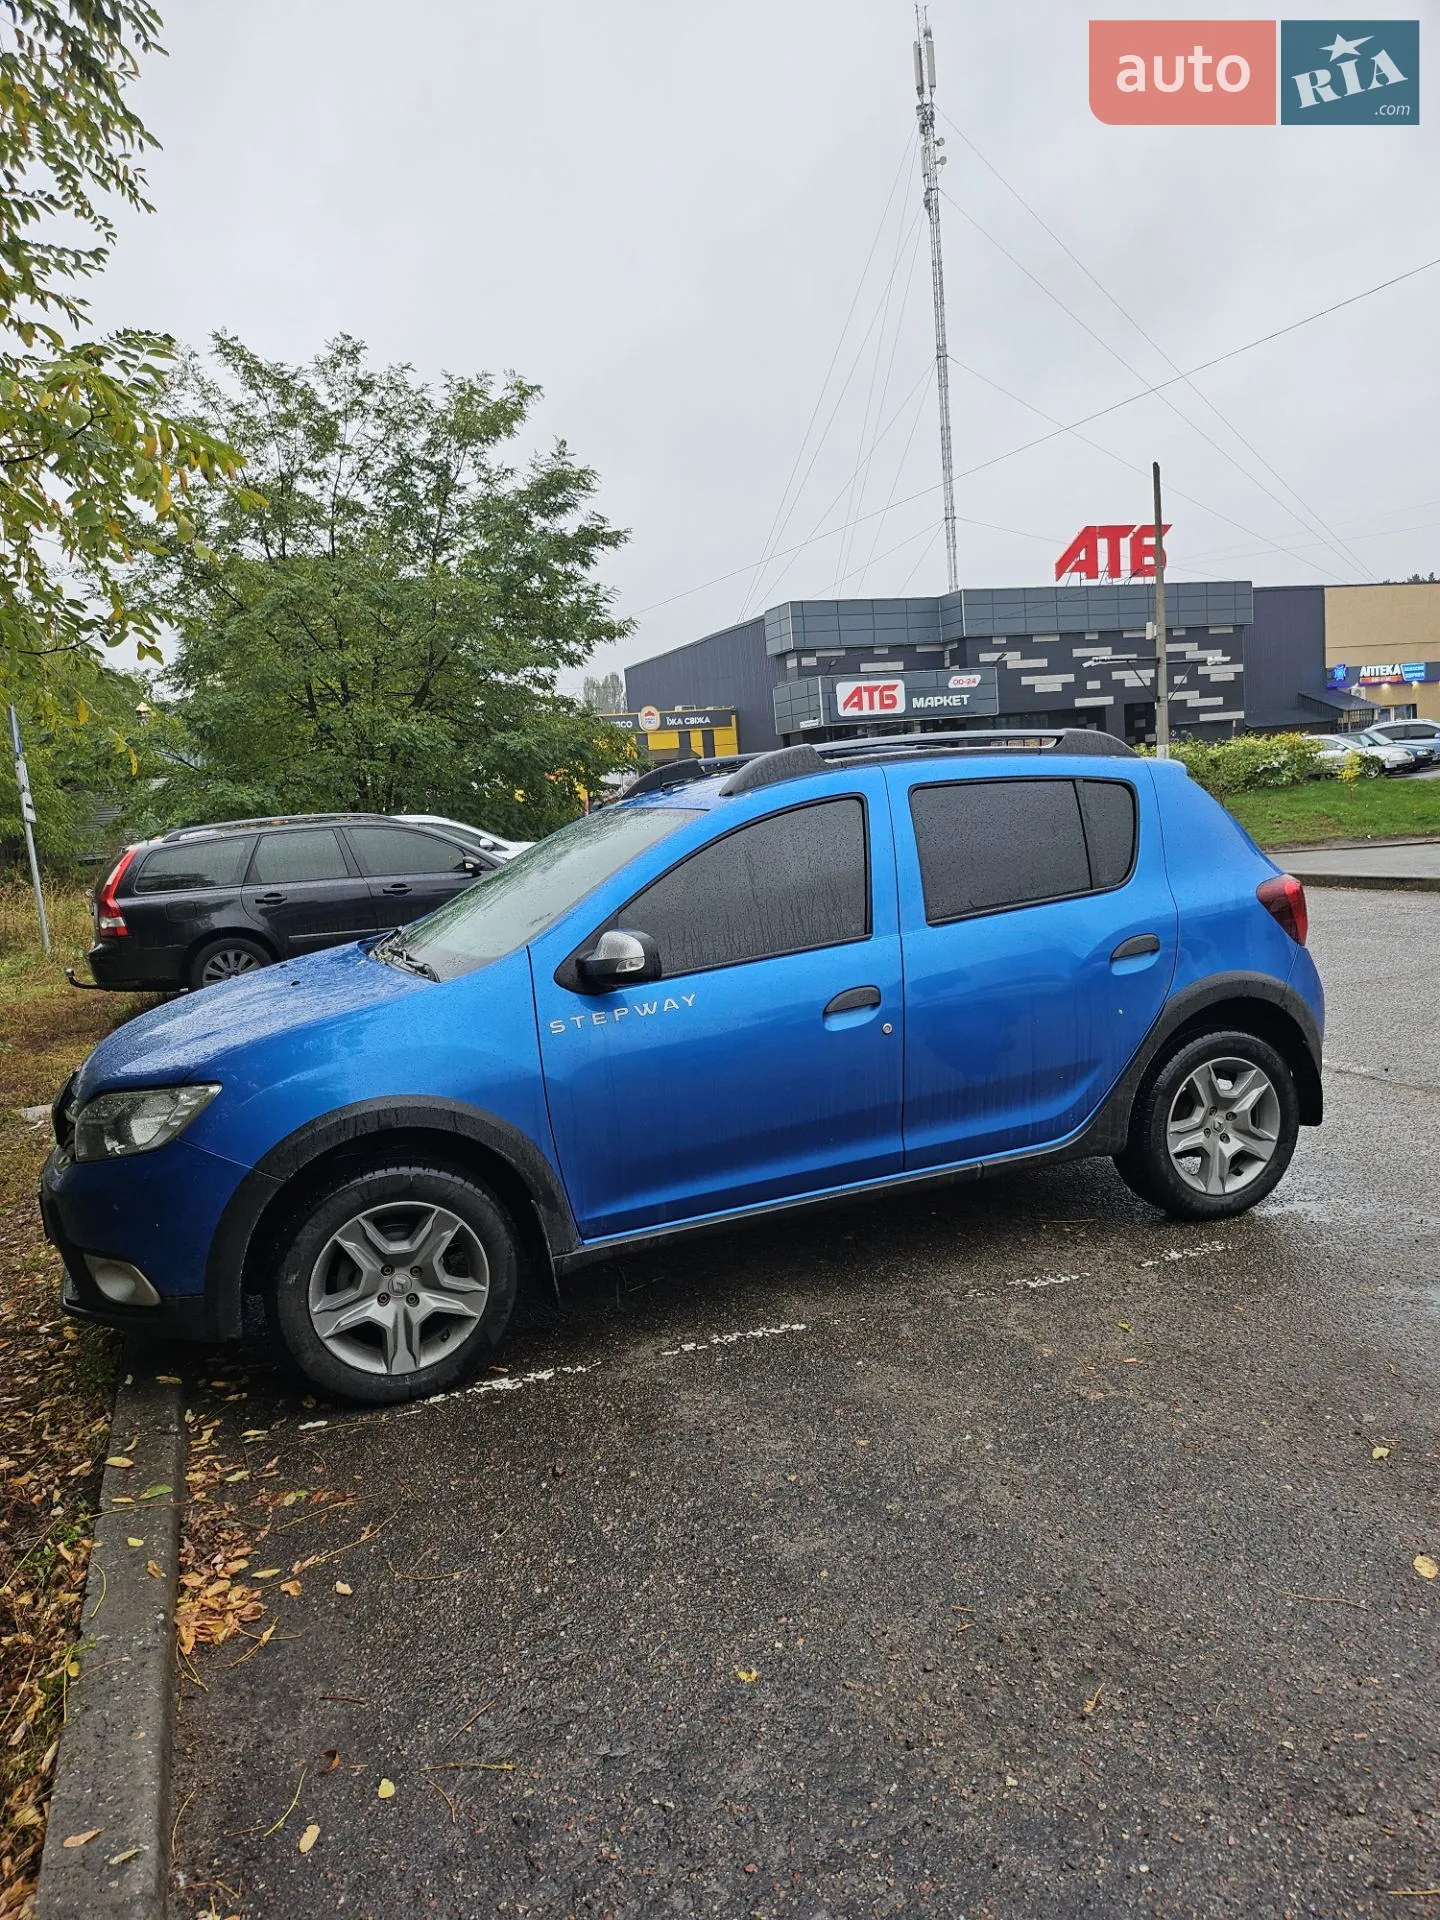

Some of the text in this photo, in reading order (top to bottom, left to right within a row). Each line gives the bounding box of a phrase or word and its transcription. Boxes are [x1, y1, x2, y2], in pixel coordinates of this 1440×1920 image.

[1360, 663, 1401, 677] АПТЕКА
[952, 677, 977, 686] 00-24
[842, 683, 971, 712] АТБ МАРКЕТ
[666, 716, 684, 726] ЇЖА
[684, 716, 711, 726] СВІЖА
[549, 993, 696, 1034] STEPWAY
